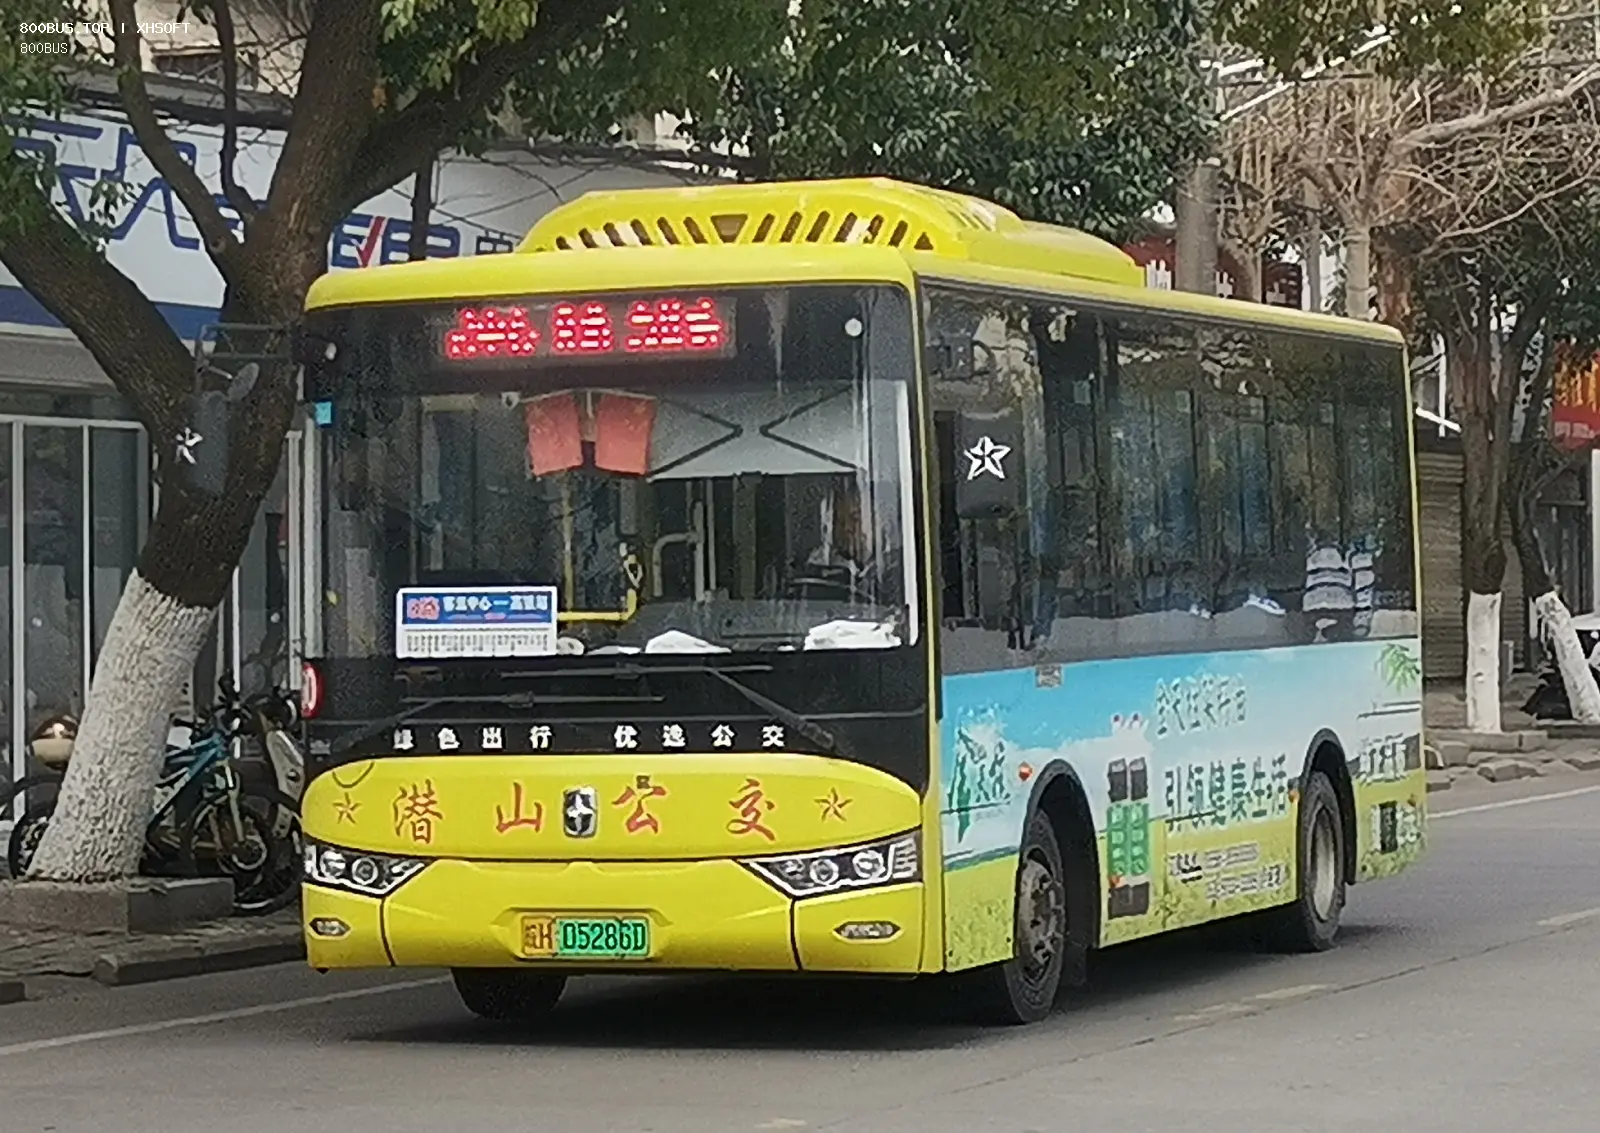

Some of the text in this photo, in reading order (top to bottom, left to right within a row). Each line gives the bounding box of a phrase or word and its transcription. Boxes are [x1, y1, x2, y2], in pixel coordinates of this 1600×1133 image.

[393, 724, 786, 750] 绿色出行 优选公交
